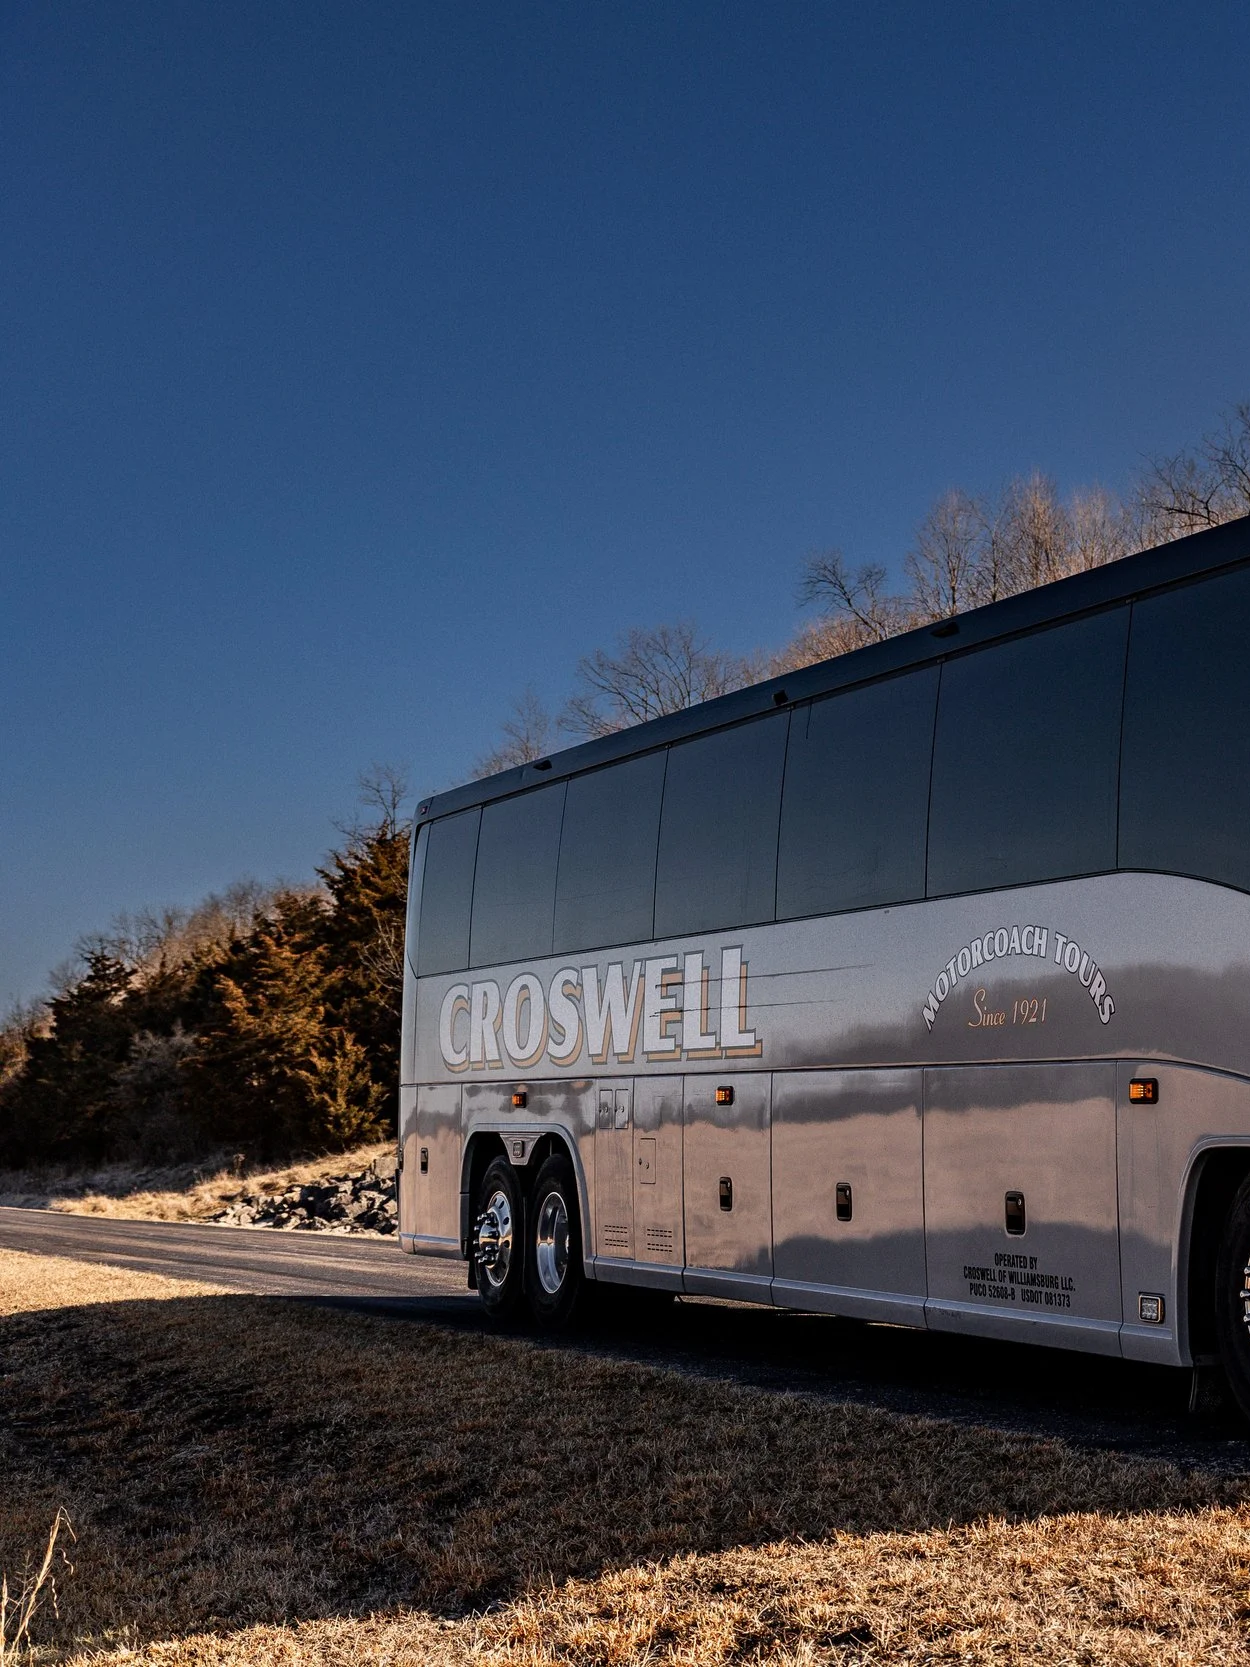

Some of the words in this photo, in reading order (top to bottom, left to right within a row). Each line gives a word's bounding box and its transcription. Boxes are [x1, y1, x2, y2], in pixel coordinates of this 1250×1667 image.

[921, 924, 1049, 1034] MOTORCOACH
[1053, 931, 1115, 1025] TOURS
[439, 944, 763, 1074] CROSWELL
[967, 988, 1006, 1027] Since
[1012, 998, 1048, 1025] 1921
[994, 1252, 1028, 1270] OPERATED
[1029, 1256, 1038, 1271] BY
[963, 1265, 997, 1283] CROSWELL
[998, 1269, 1007, 1284] OF
[1008, 1270, 1060, 1290] WILLIAMSBURG
[1061, 1276, 1076, 1292] LLC.
[969, 1282, 987, 1298] PUCO
[1021, 1288, 1043, 1305] USDOT
[1044, 1291, 1071, 1308] 081373
